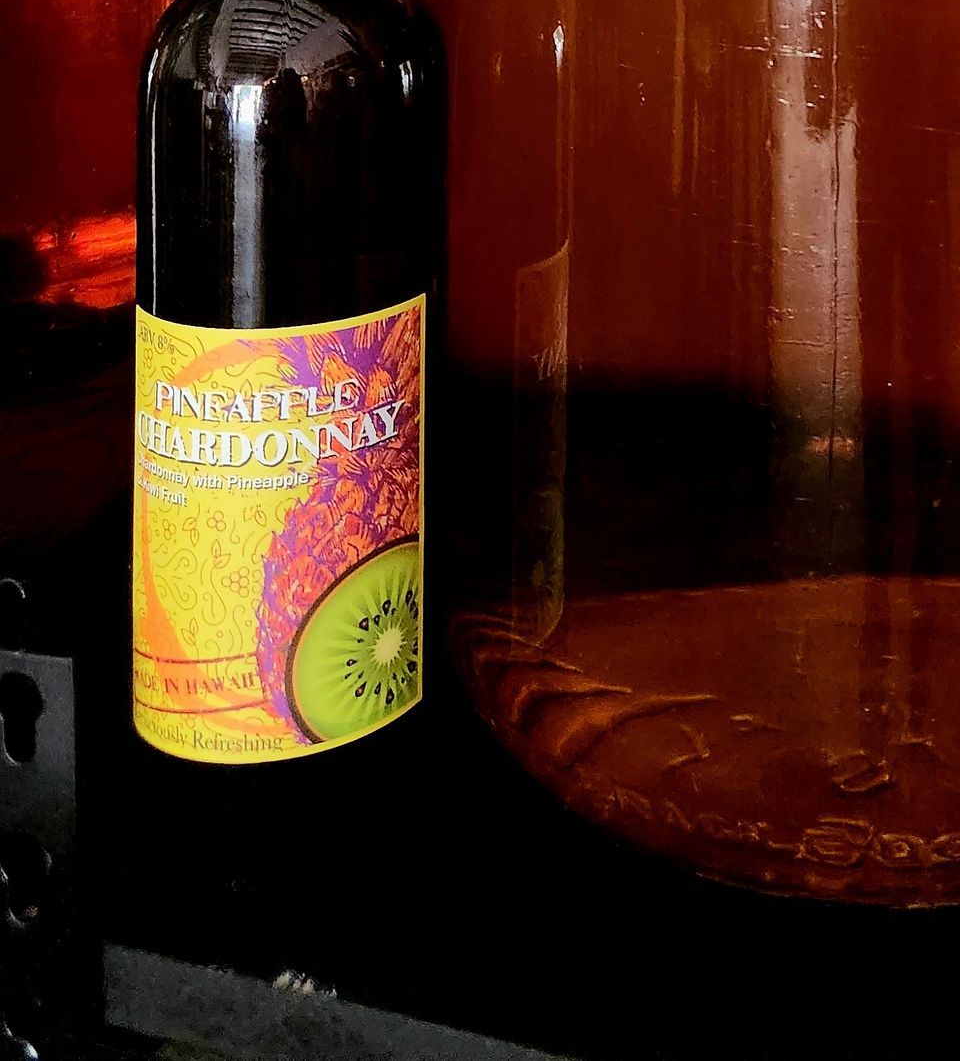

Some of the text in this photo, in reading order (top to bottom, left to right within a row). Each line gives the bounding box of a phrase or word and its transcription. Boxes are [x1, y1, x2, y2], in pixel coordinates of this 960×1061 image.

[154, 378, 361, 423] PINEAPPLE
[138, 399, 406, 467] CHARDONNAY
[193, 474, 223, 489] with
[228, 469, 310, 491] Pineapple
[162, 488, 187, 507] Fruit
[164, 677, 180, 694] IN
[192, 729, 283, 752] Refreshing
